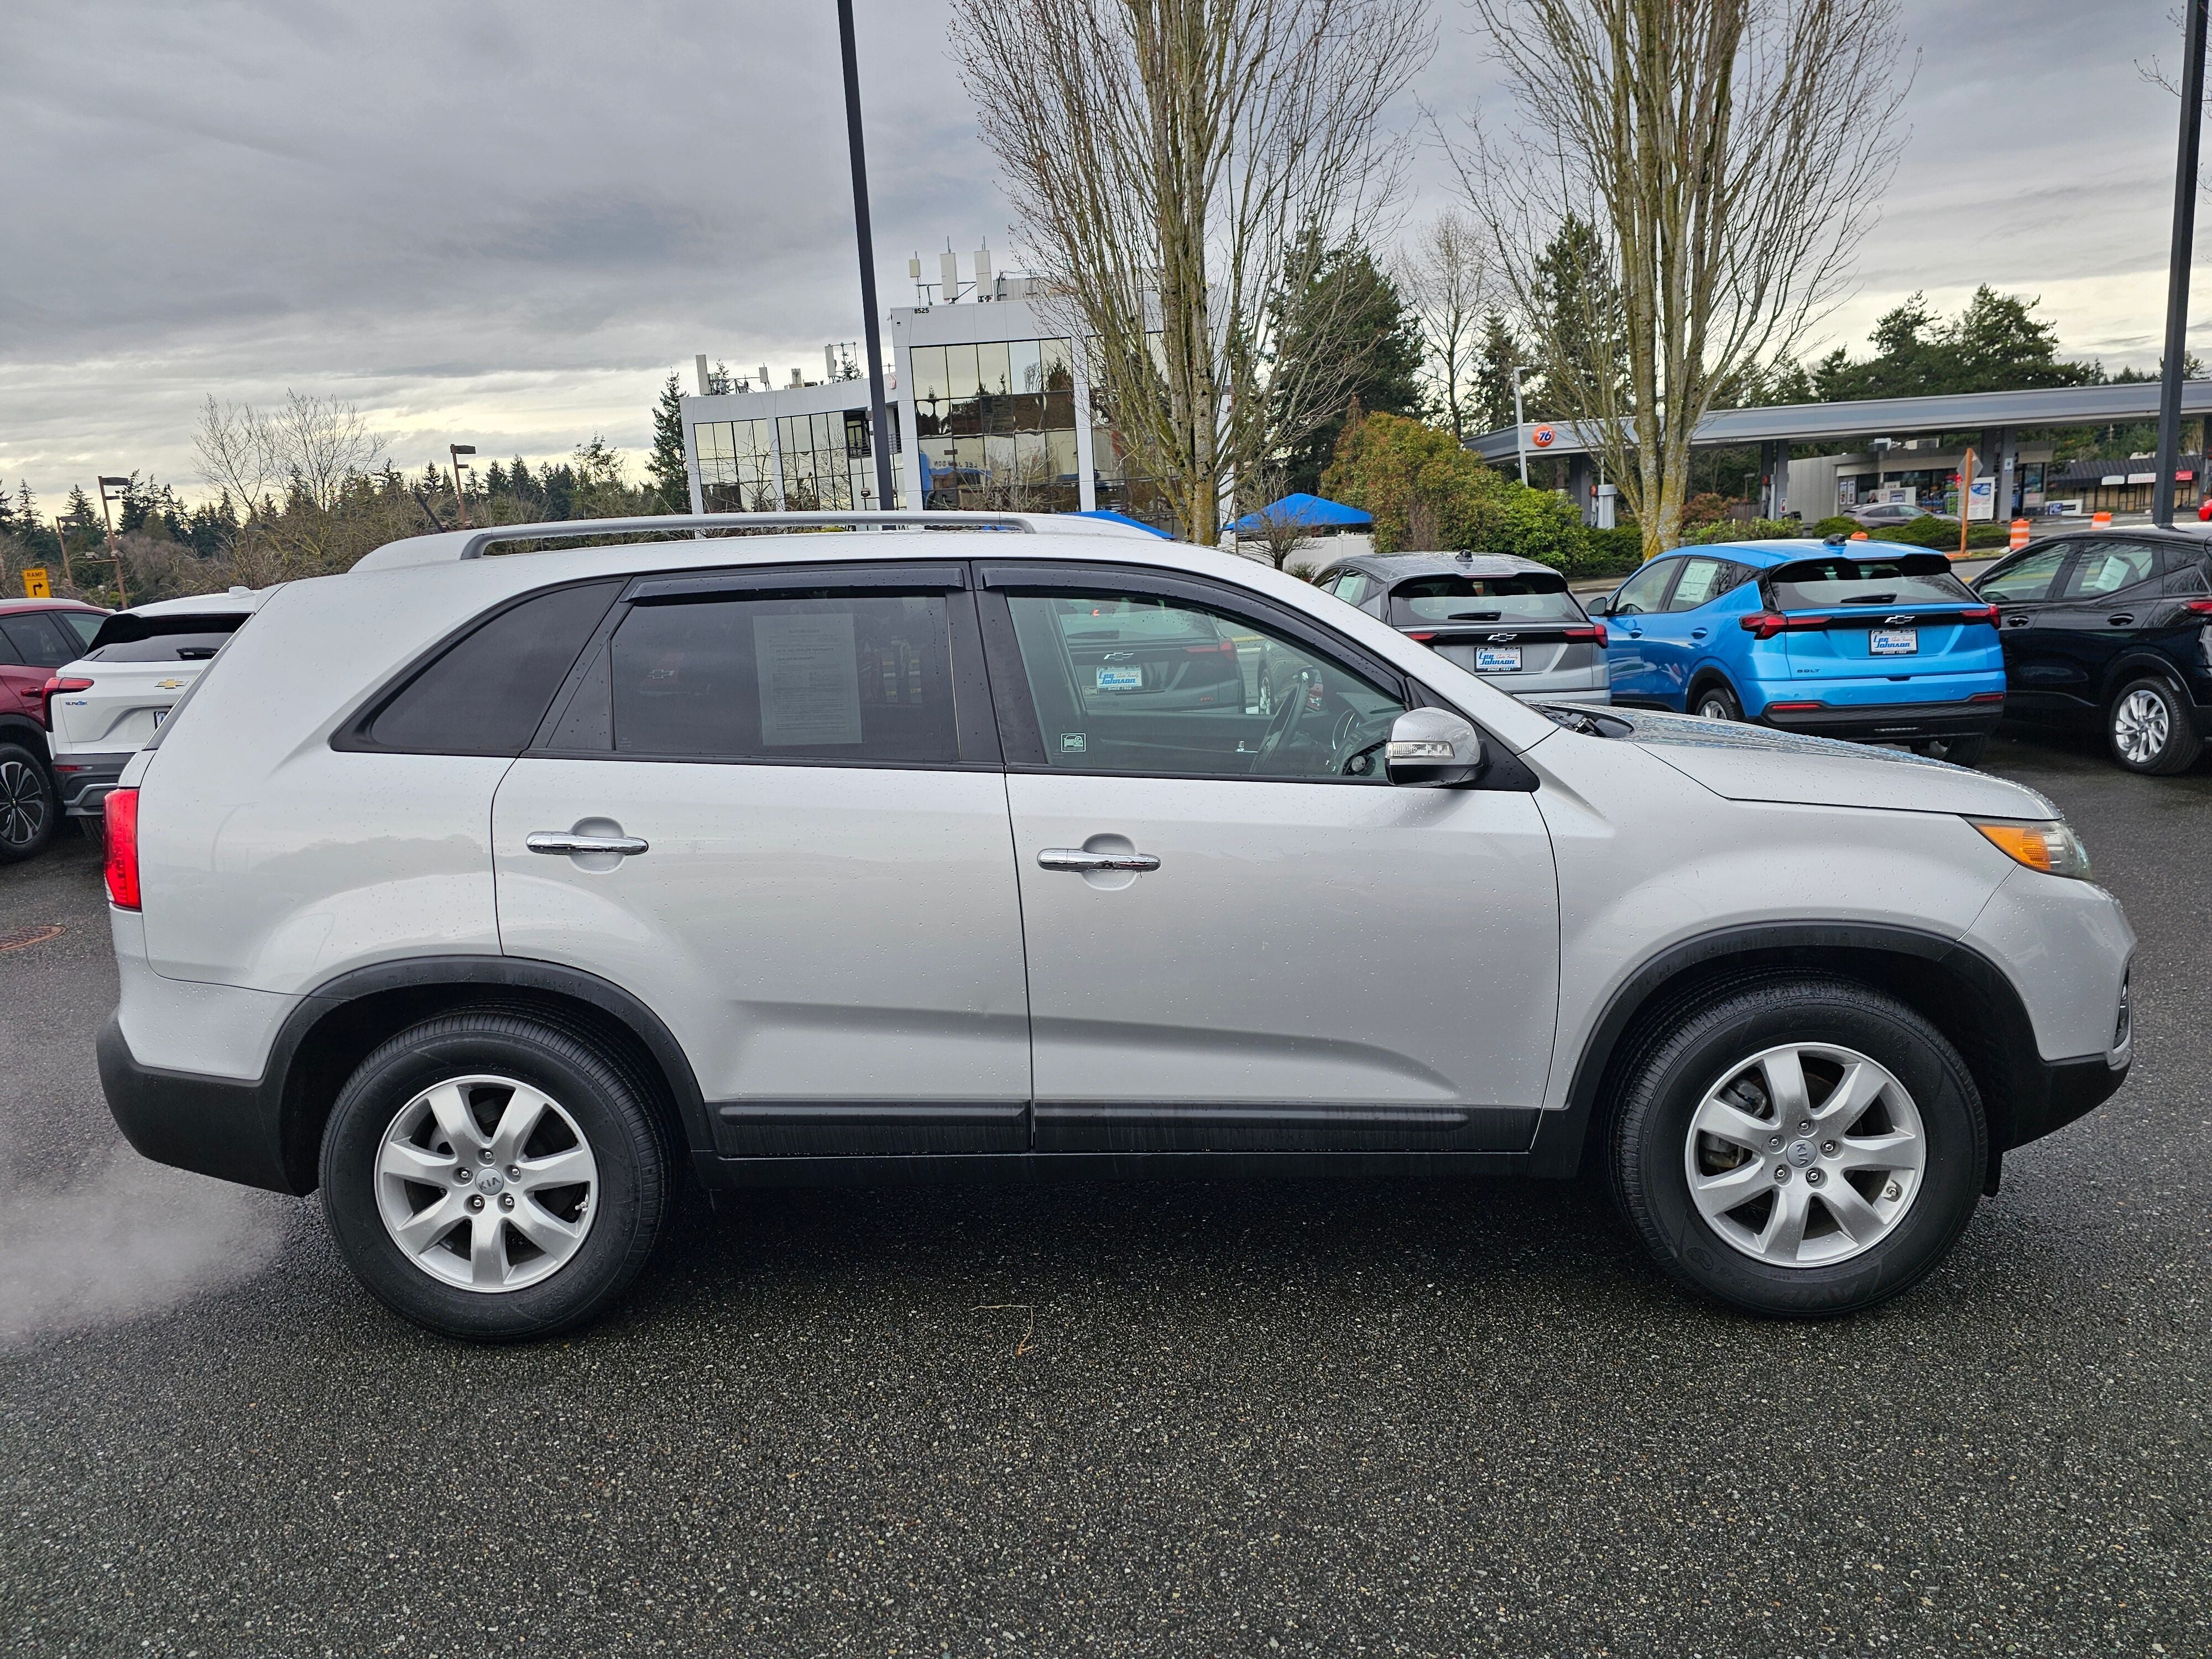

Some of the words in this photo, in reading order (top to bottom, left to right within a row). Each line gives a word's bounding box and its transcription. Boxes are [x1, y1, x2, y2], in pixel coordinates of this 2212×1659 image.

[1540, 431, 1552, 441] 76
[1796, 1143, 1809, 1166] KIA
[478, 1177, 500, 1190] KIA
